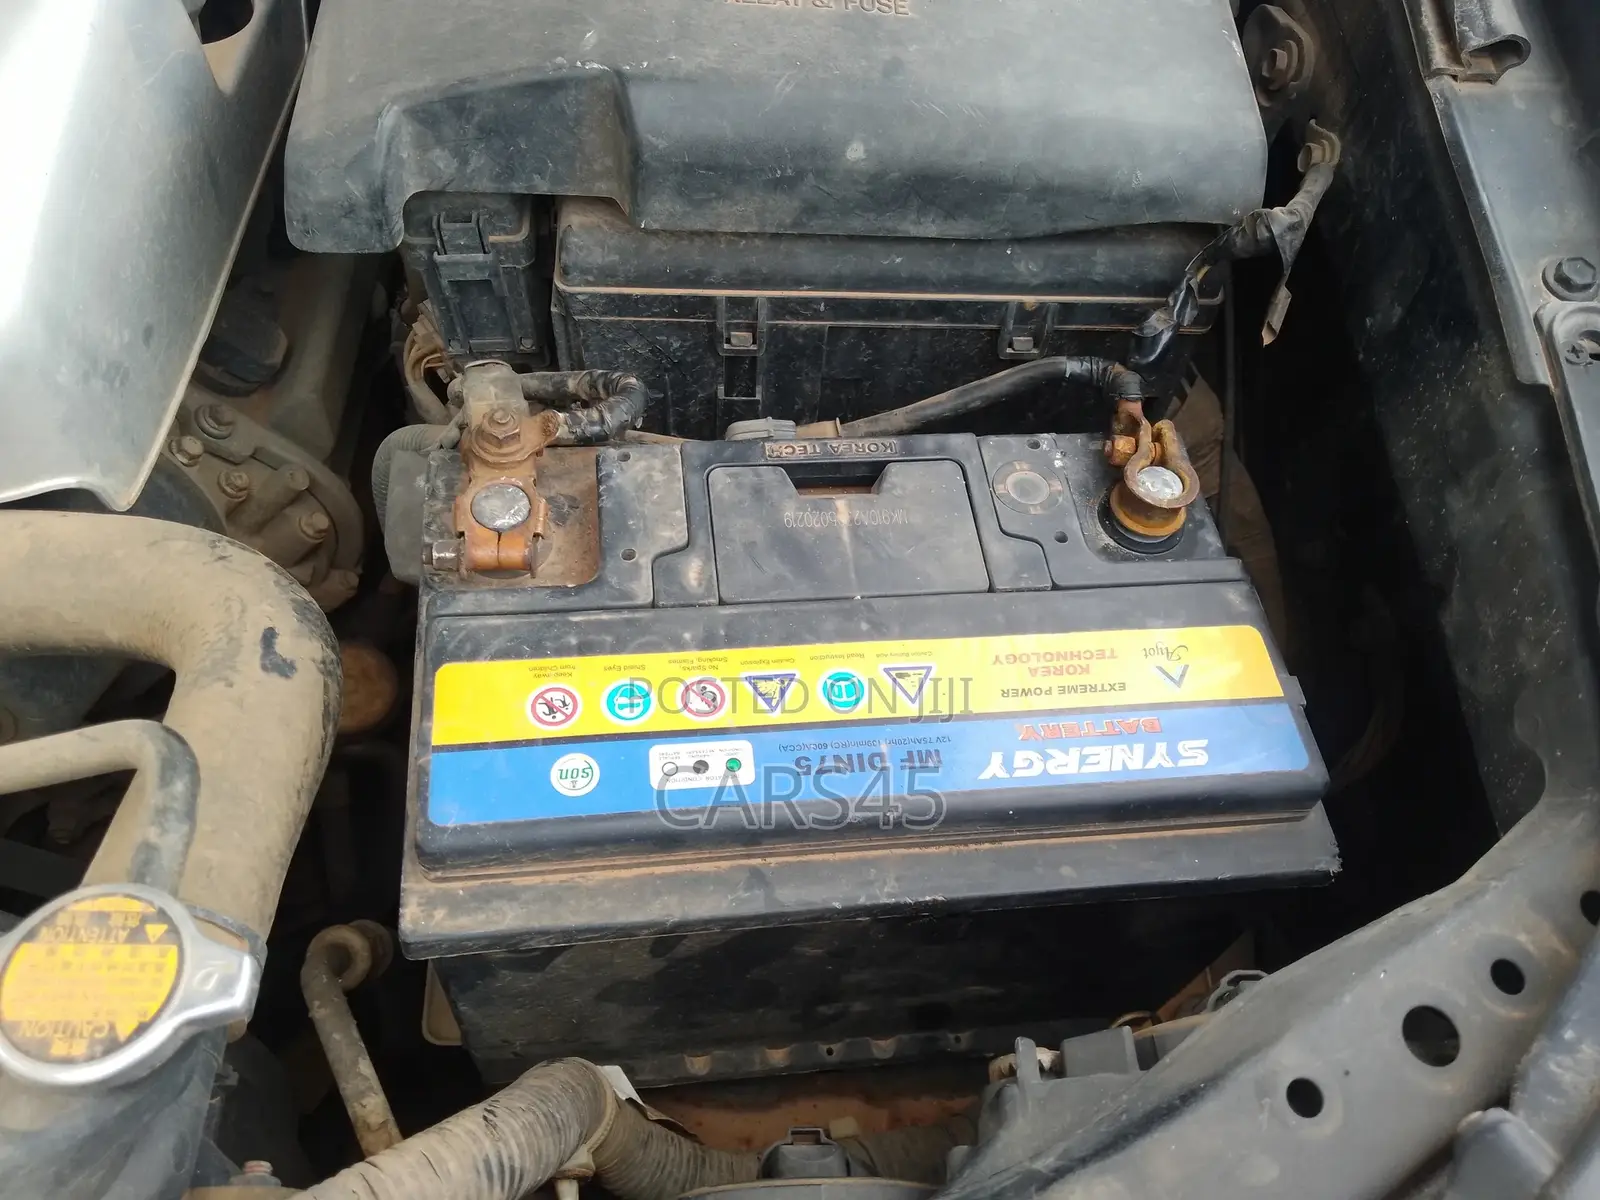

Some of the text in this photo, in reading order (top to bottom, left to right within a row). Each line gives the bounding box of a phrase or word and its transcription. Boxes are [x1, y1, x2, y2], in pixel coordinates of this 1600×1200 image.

[843, 0, 910, 15] FUSE
[767, 441, 896, 458] KOREA TECH
[696, 656, 728, 664] Smoking,
[993, 648, 1118, 666] TECHNOLOGY
[603, 664, 623, 672] Eyes
[1028, 663, 1090, 678] KOREA
[1001, 682, 1126, 698] EXTREME POWER
[1018, 716, 1163, 741] BATTERY
[935, 736, 952, 744] 12V
[794, 748, 943, 776] MF DIN75
[977, 738, 1209, 780] SYNERGY
[37, 924, 131, 944] ATTENTION
[17, 1019, 110, 1038] CAUTION
